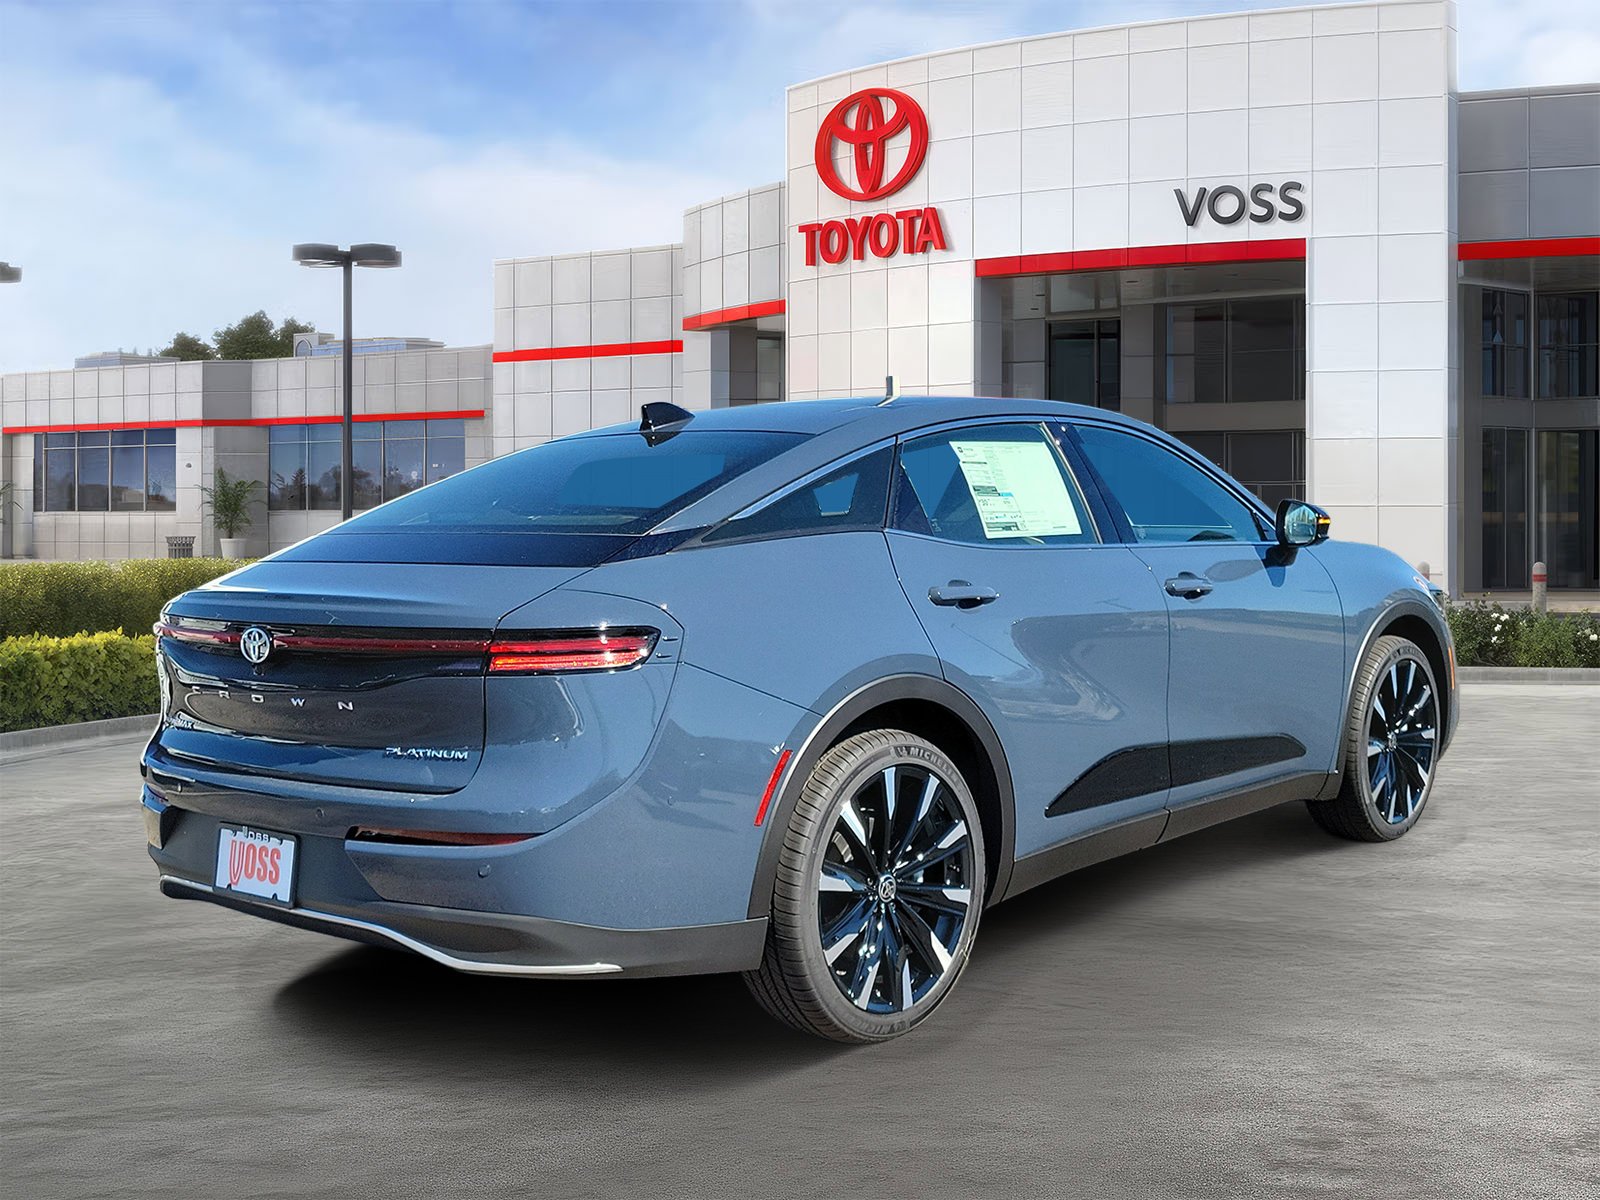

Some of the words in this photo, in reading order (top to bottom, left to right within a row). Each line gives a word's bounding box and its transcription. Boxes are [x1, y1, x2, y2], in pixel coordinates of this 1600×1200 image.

[1173, 181, 1306, 227] VOSS
[798, 206, 948, 267] TOYOTA
[192, 685, 354, 711] CROWN
[385, 746, 469, 759] PLATINUM
[229, 840, 281, 886] VOSS
